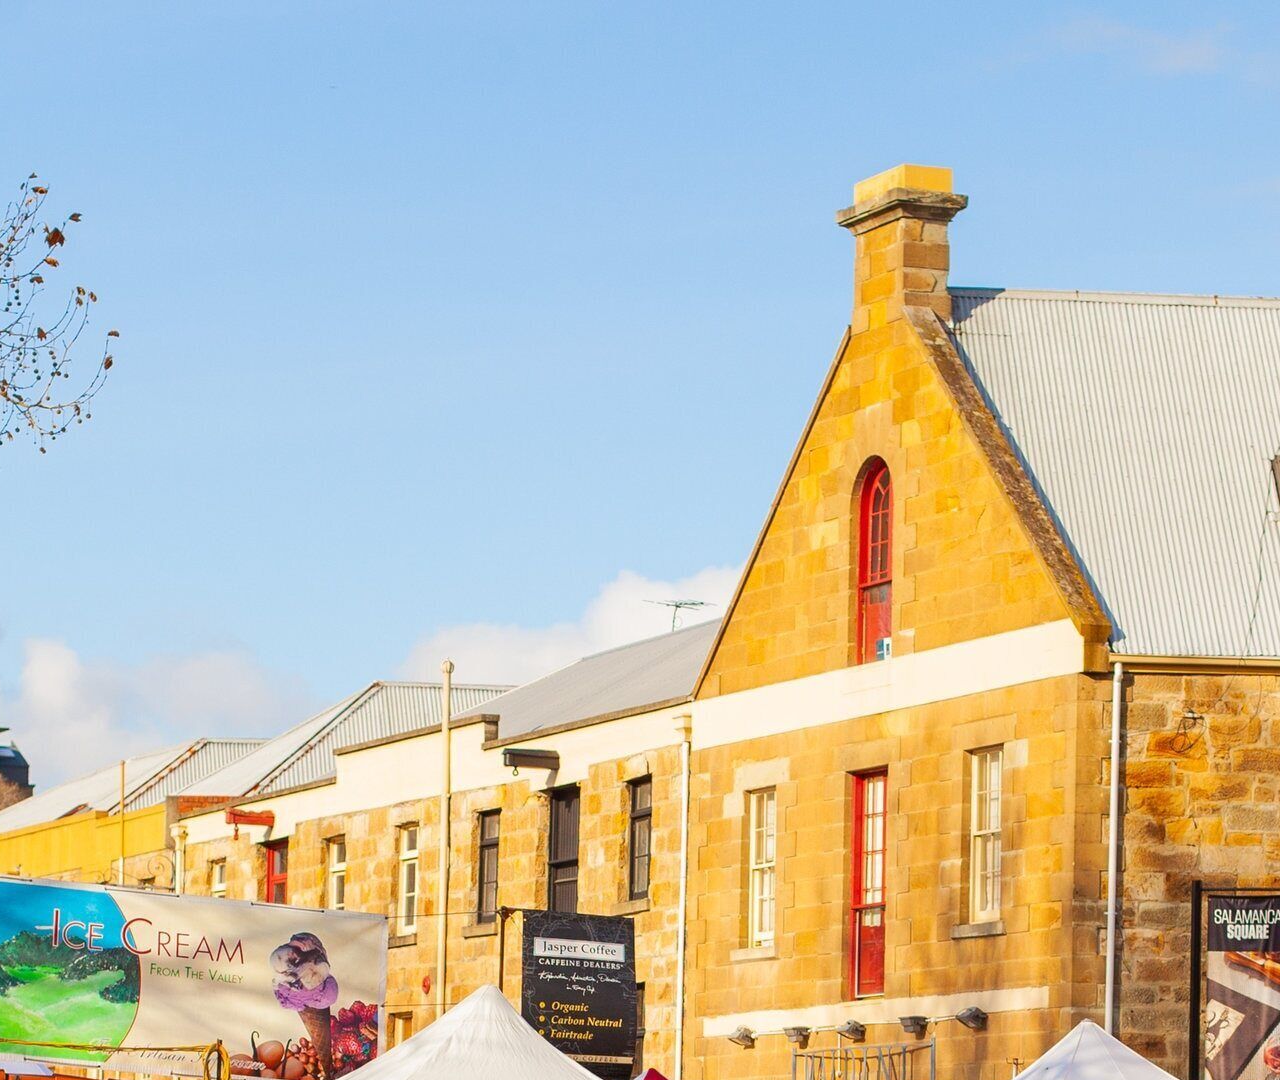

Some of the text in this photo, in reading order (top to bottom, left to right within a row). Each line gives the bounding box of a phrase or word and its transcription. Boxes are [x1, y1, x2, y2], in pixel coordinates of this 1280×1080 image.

[52, 908, 244, 965] ICE CREAM
[1227, 924, 1270, 941] SQUARE
[543, 941, 617, 956] Jasper Coffee
[538, 957, 580, 967] CAFFEINE
[552, 1002, 590, 1013] Organic
[551, 1015, 623, 1028] Carbon Neutral
[550, 1029, 594, 1040] Fairtrade
